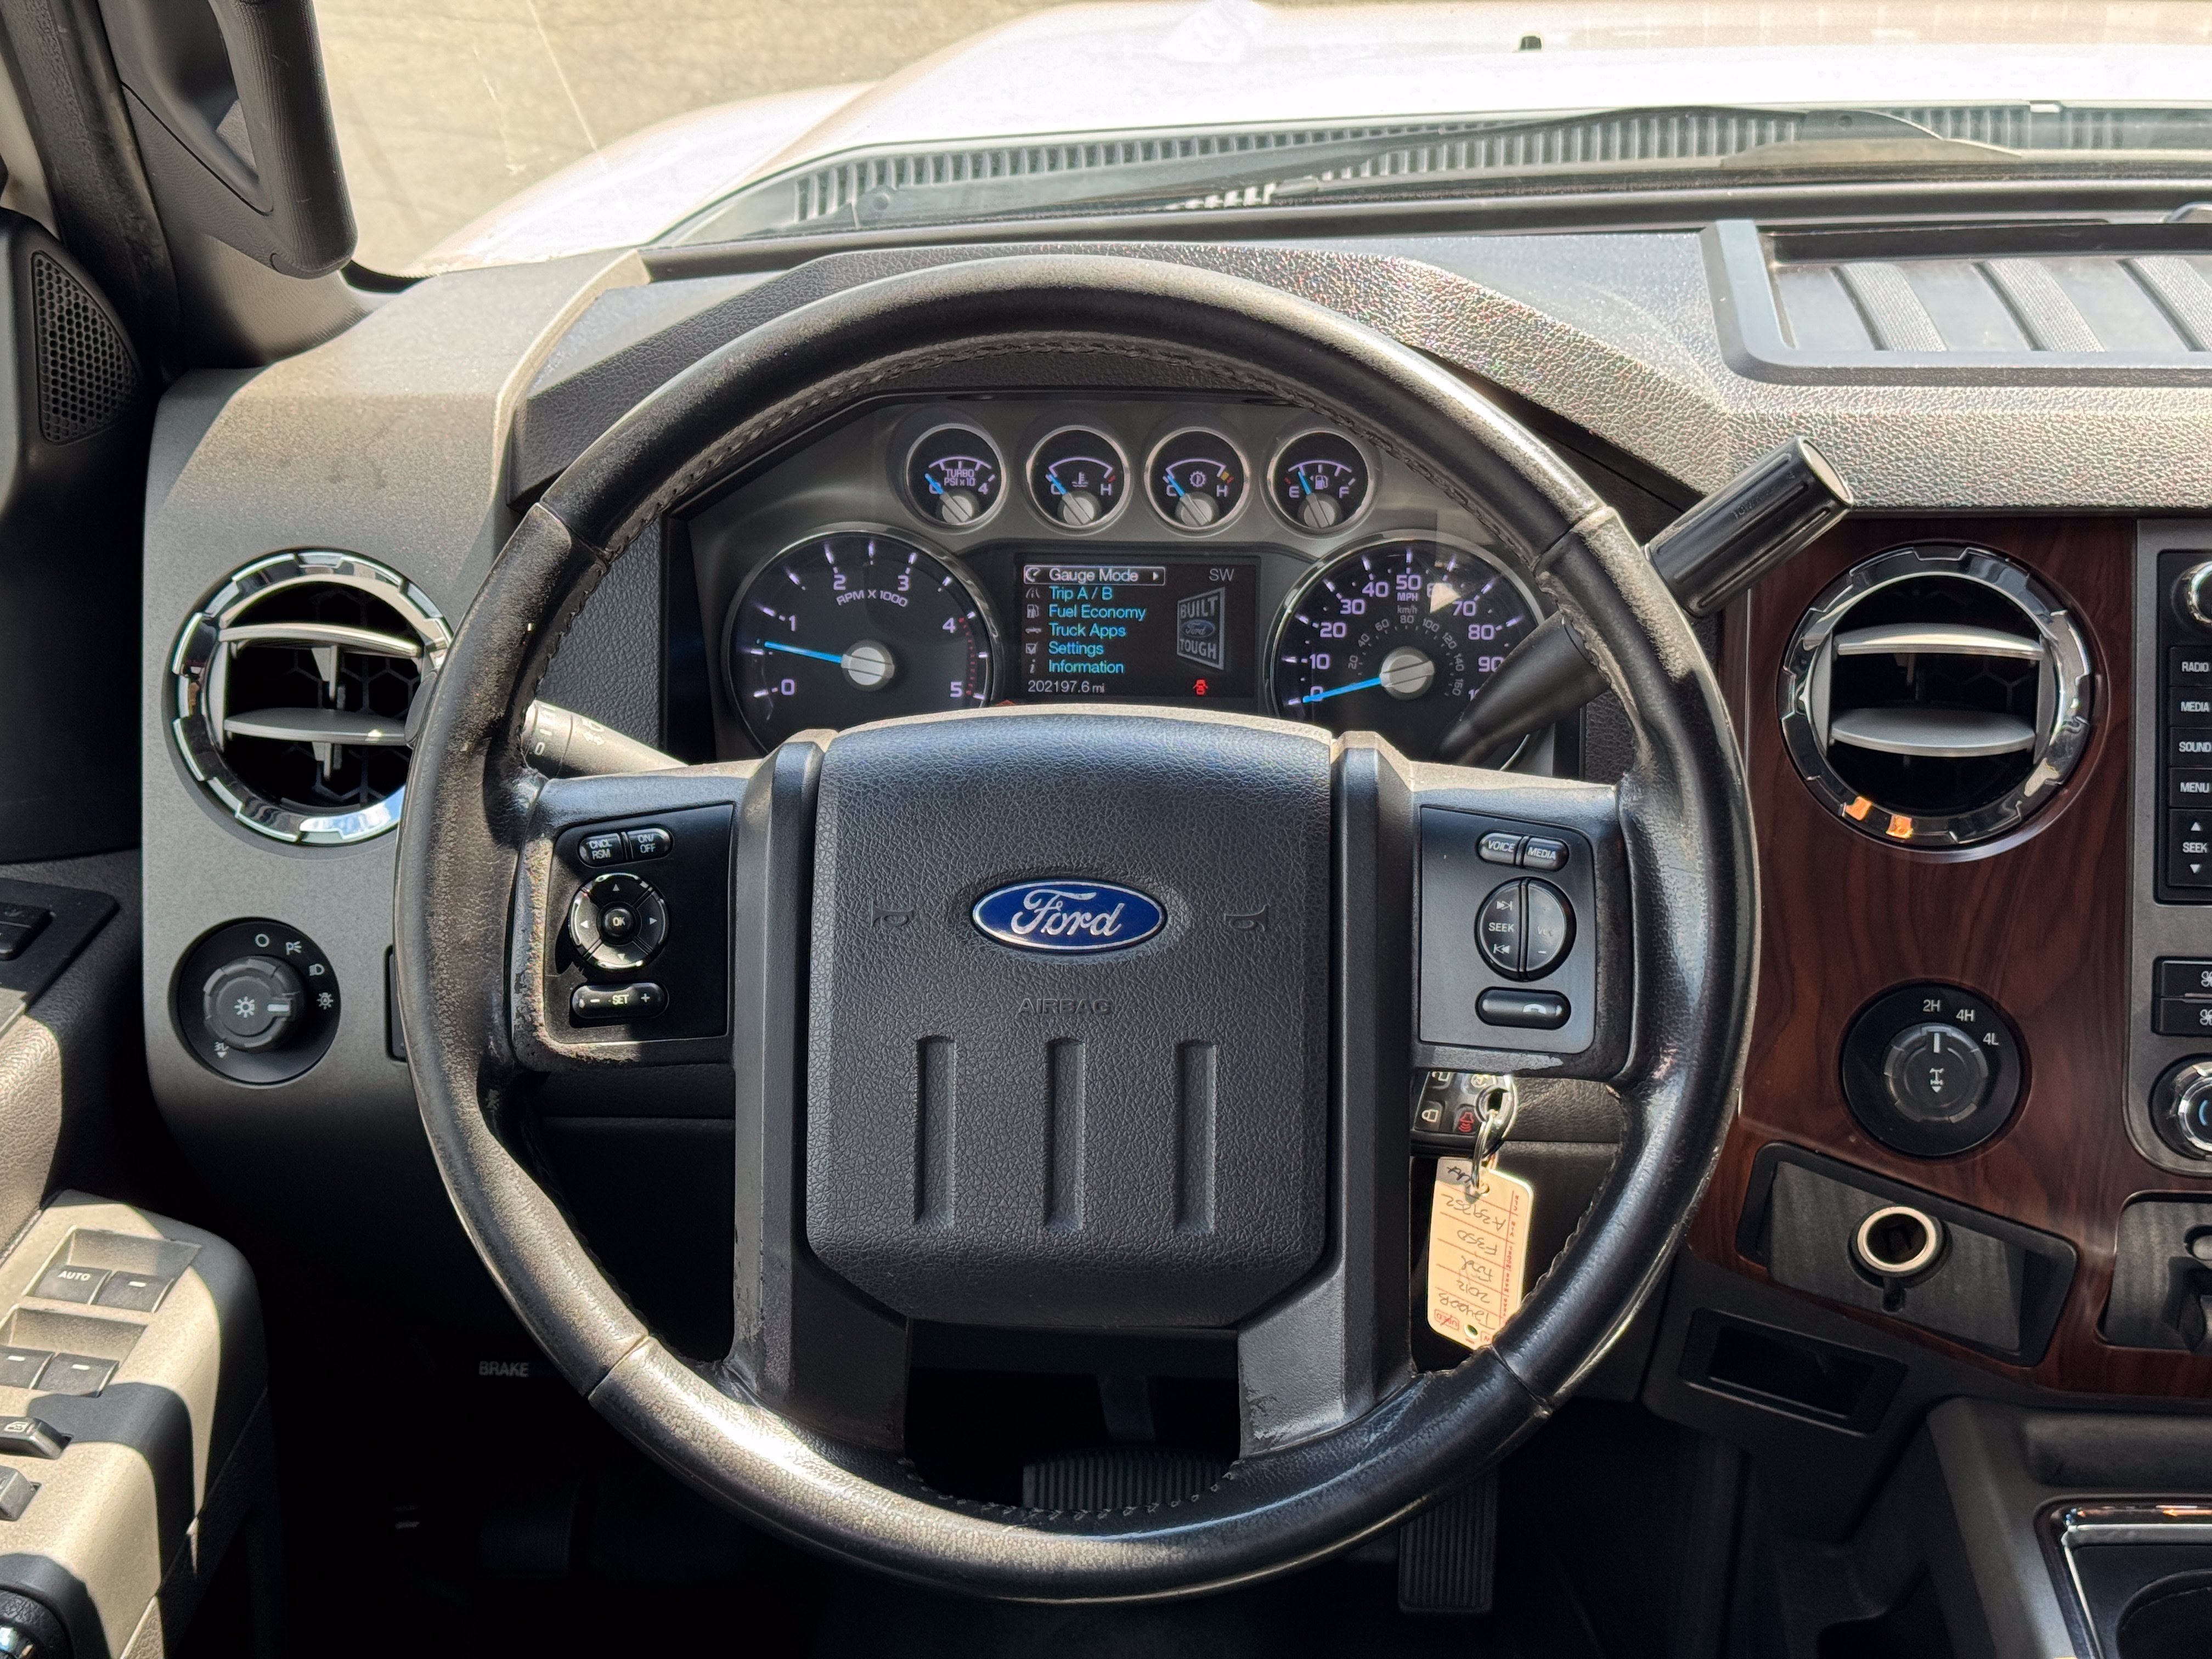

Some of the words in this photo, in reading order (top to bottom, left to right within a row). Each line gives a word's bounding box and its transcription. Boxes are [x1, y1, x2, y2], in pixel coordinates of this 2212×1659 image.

[945, 469, 974, 478] TURBO
[944, 478, 958, 486] PSI
[978, 483, 988, 495] 4
[1101, 484, 1112, 496] H
[1217, 486, 1228, 497] H
[1289, 487, 1300, 498] E
[1339, 487, 1350, 498] F
[833, 574, 846, 590] 2
[1049, 568, 1095, 582] Gauge
[1099, 568, 1138, 582] Mode
[1209, 568, 1234, 582] SW
[898, 575, 910, 591] 3
[1362, 582, 1389, 597] 40
[1396, 575, 1421, 591] 50
[837, 590, 865, 606] RPM
[868, 589, 877, 599] X
[880, 590, 909, 607] 1000
[1049, 586, 1073, 601] Trip
[1077, 587, 1088, 600] A
[1091, 587, 1098, 600] /
[1102, 587, 1113, 600] B
[1397, 592, 1418, 601] MPH
[1049, 606, 1077, 618] Fuel
[1081, 606, 1146, 622] Economy
[1180, 596, 1218, 619] BUILT
[1340, 599, 1365, 615] 30
[1397, 606, 1418, 614] km/h
[1453, 601, 1476, 617] 70
[789, 616, 796, 631] 1
[943, 618, 956, 634] 4
[1374, 618, 1390, 631] 60
[1400, 615, 1414, 624] 80
[1422, 618, 1440, 633] 100
[1049, 624, 1086, 637] Truck
[1089, 624, 1126, 640] Apps
[1185, 621, 1207, 636] Ford
[1320, 622, 1346, 638] 20
[1468, 625, 1494, 640] 80
[1358, 633, 1370, 648] 40
[1441, 631, 1457, 650] 120
[1048, 641, 1104, 657] Settings
[1180, 638, 1217, 660] TOUGH
[1049, 660, 1124, 674] Information
[1310, 654, 1330, 670] 10
[1348, 654, 1359, 670] 20
[1453, 653, 1465, 672] 140
[2182, 662, 2209, 673] RADIO
[781, 679, 795, 696] 0
[950, 682, 963, 698] 5
[1028, 680, 1090, 693] 202197.6
[1092, 682, 1104, 693] mi
[1452, 678, 1465, 696] 160
[2181, 702, 2209, 713] MEDIA
[2179, 741, 2211, 753] SOUND
[2180, 782, 2209, 793] MENU
[588, 839, 612, 849] CNCL
[640, 843, 656, 853] OFF
[1488, 840, 1515, 853] VOICE
[2182, 842, 2207, 854] SEEK
[591, 849, 611, 860] RSM
[1527, 847, 1556, 860] MEDIA
[1011, 889, 1125, 936] Ford
[612, 916, 625, 927] OK
[1488, 922, 1514, 933] SEEK
[612, 994, 629, 1005] SET
[1018, 998, 1113, 1015] AIRBAG
[1923, 999, 1940, 1012] 2H
[1956, 1009, 1974, 1022] 4H
[1983, 1032, 1999, 1045] 4L
[1457, 1229, 1498, 1255] F350
[1461, 1255, 1493, 1282] Ford
[58, 1271, 91, 1282] AUTO
[1456, 1279, 1491, 1304] 2012
[478, 1361, 529, 1378] BRAKE
